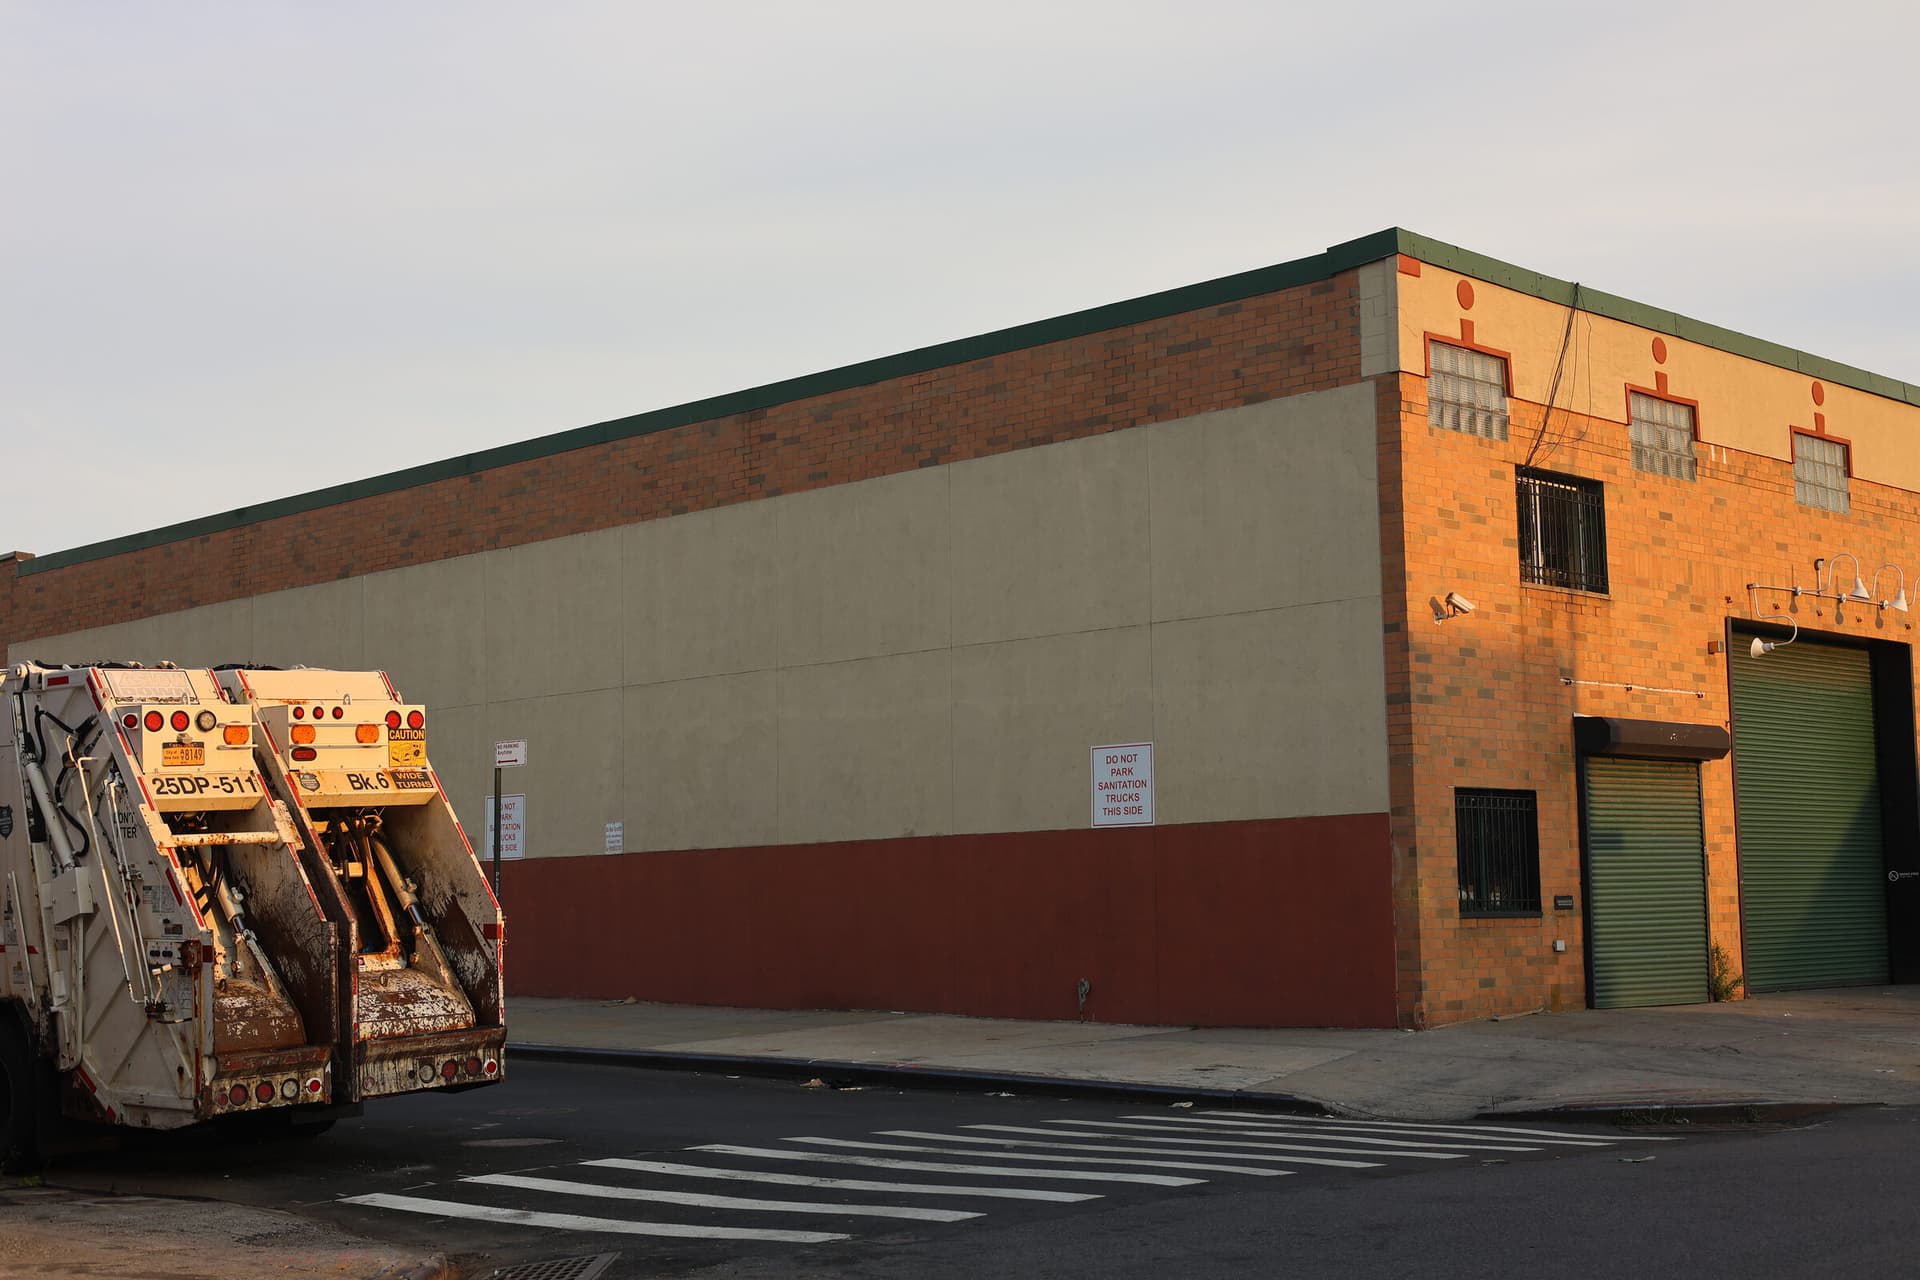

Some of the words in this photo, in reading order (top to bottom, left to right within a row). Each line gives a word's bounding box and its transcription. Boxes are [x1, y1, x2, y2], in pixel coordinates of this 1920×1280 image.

[389, 729, 424, 740] CAUTION
[1106, 755, 1118, 765] DO
[1120, 754, 1138, 764] NOT
[396, 772, 424, 780] WIDE
[1110, 767, 1134, 777] PARK
[152, 776, 258, 795] 25DP-511
[346, 772, 389, 791] Bk.6
[396, 780, 433, 789] TURNS
[1098, 779, 1147, 791] SANITATION
[1105, 793, 1140, 803] TRUCKS
[1102, 806, 1121, 816] THIS
[1123, 805, 1143, 816] SIDE
